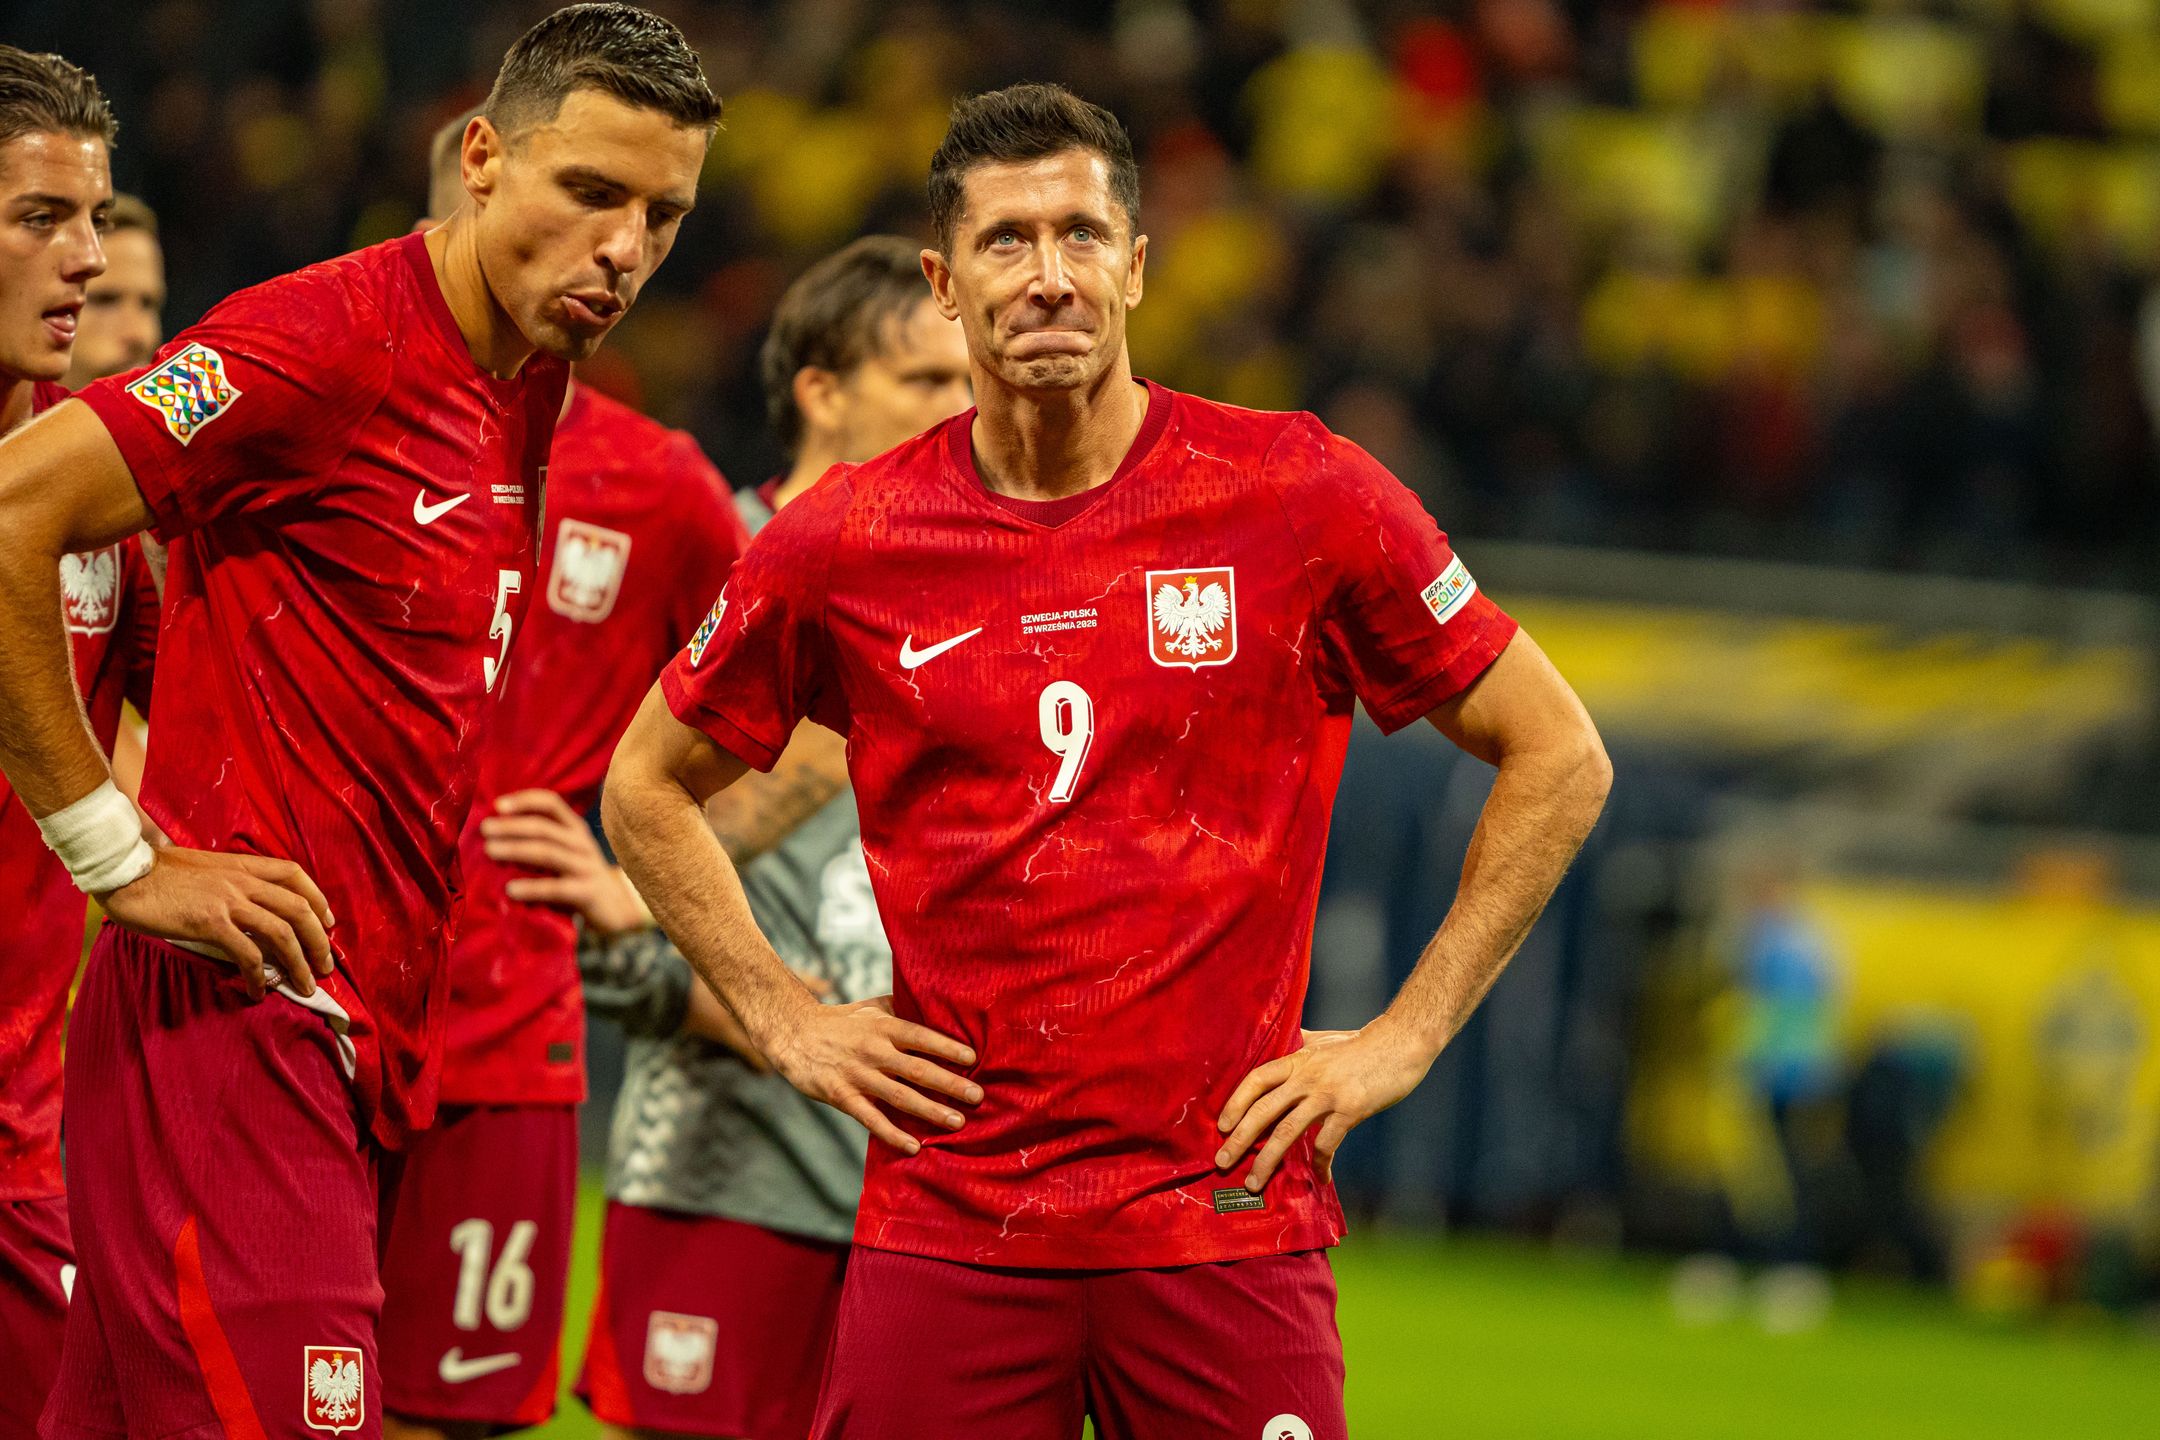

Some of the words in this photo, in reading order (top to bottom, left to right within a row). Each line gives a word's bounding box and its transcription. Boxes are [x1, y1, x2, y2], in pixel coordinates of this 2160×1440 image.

[1020, 608, 1098, 624] SZWECJA-POLSKA
[1425, 581, 1443, 600] UEFA
[483, 569, 521, 694] 5
[1023, 626, 1033, 634] 28
[1034, 621, 1076, 633] WRZEŚNIA
[1076, 620, 1097, 629] 2026
[1038, 680, 1094, 802] 9
[450, 1217, 539, 1332] 16
